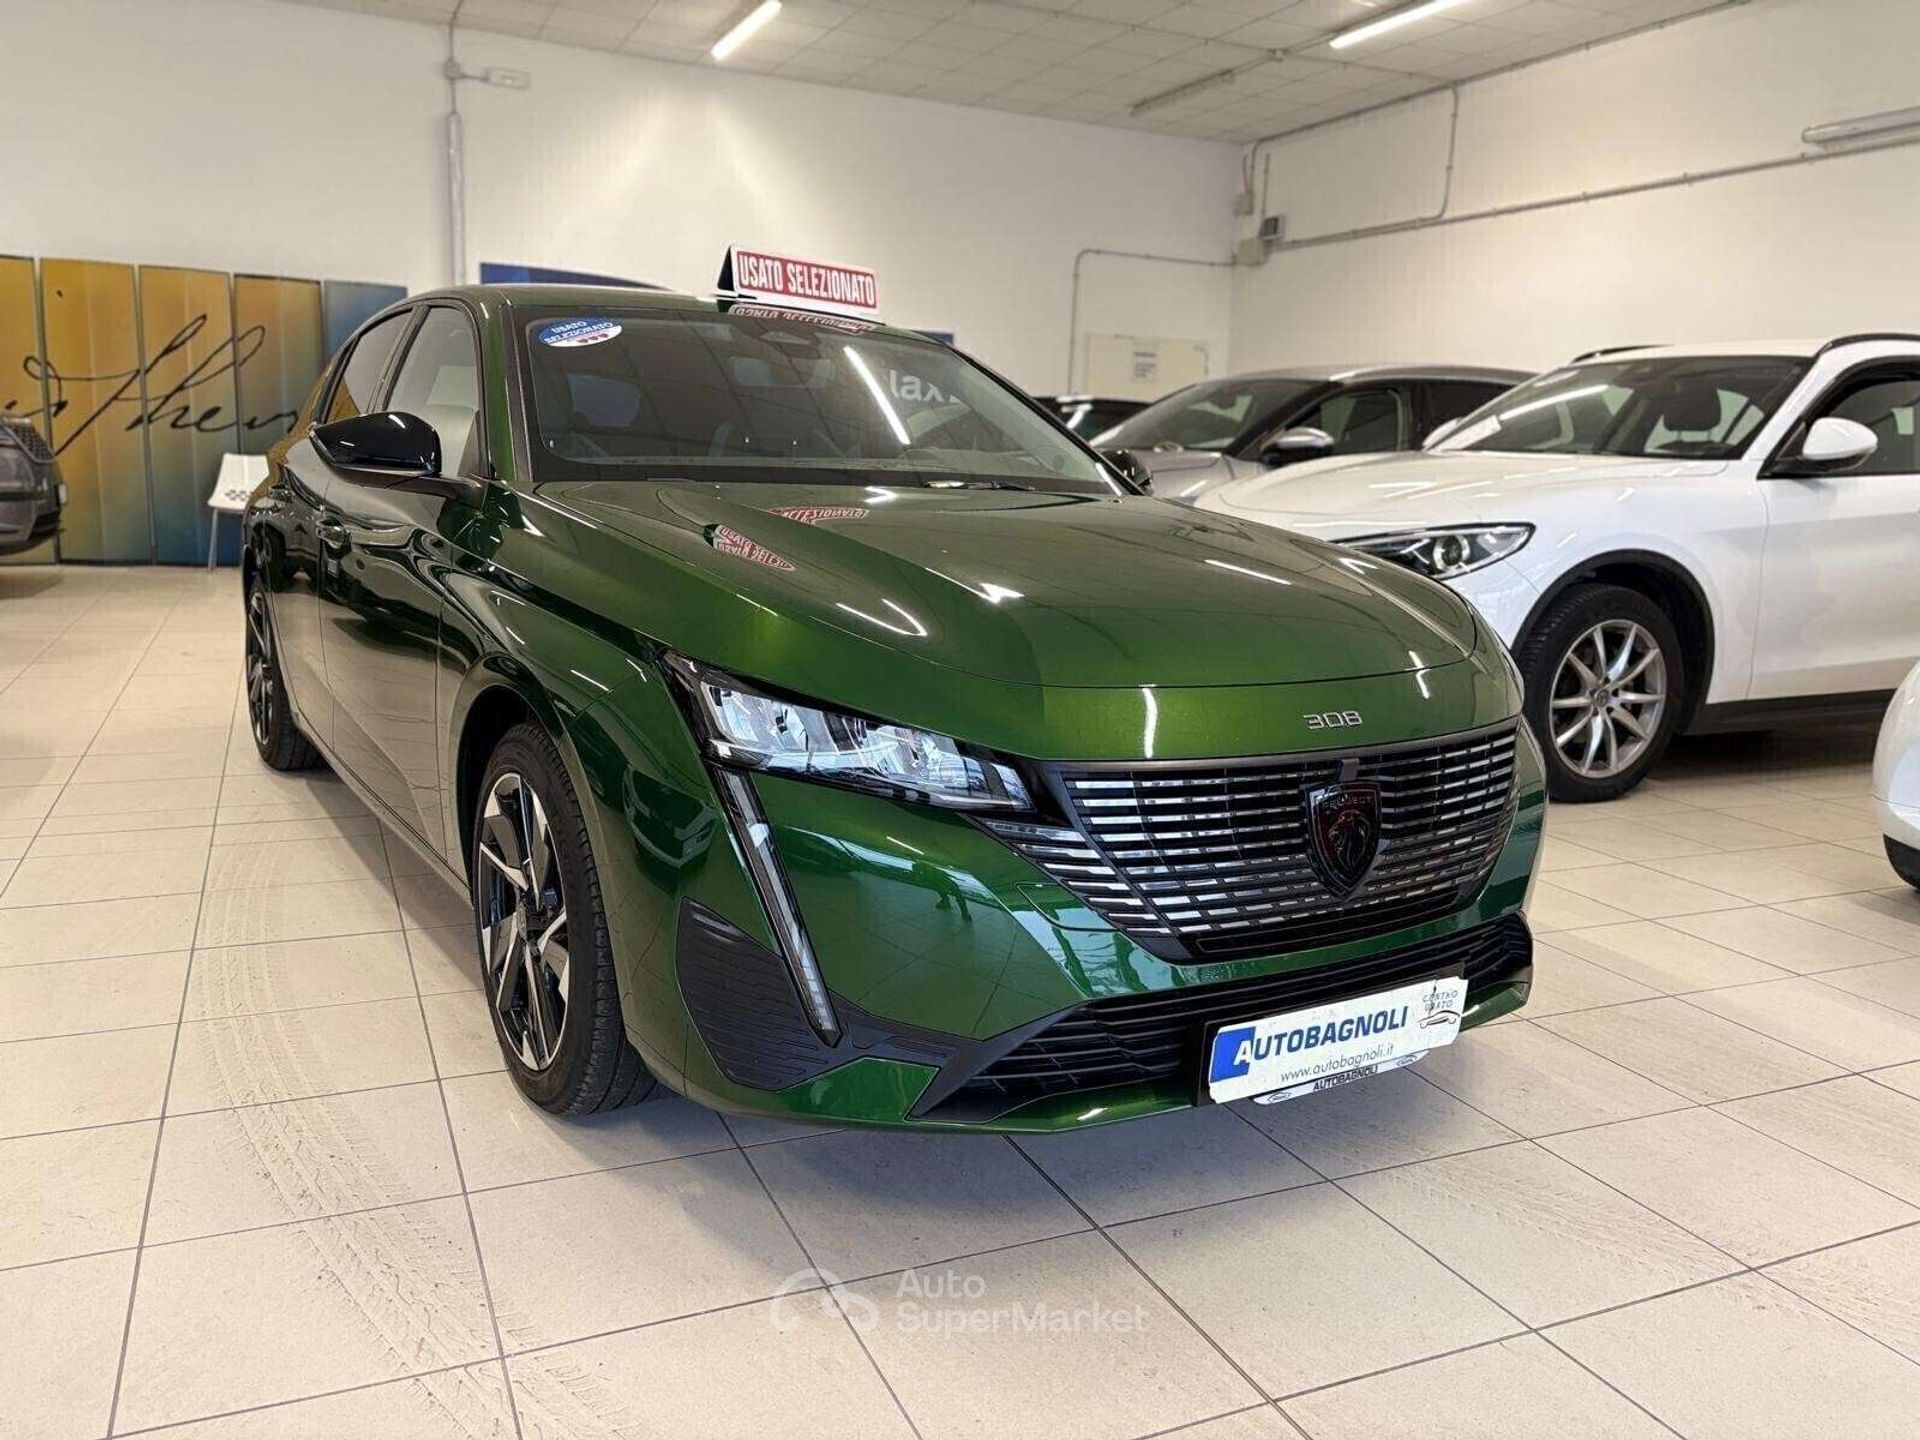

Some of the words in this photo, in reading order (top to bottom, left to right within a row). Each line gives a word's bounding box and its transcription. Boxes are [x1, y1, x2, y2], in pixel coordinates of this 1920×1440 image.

[738, 253, 785, 291] USATO
[786, 261, 875, 307] SELEZIONATO
[543, 321, 614, 343] SELEZIONATO
[551, 320, 588, 334] USATO
[1302, 710, 1363, 730] 308
[1233, 1005, 1410, 1066] AUTOBAGNOLI
[1280, 1044, 1395, 1083] www.autobagnoli.it
[1312, 1065, 1379, 1092] AUTOBAGNOLI
